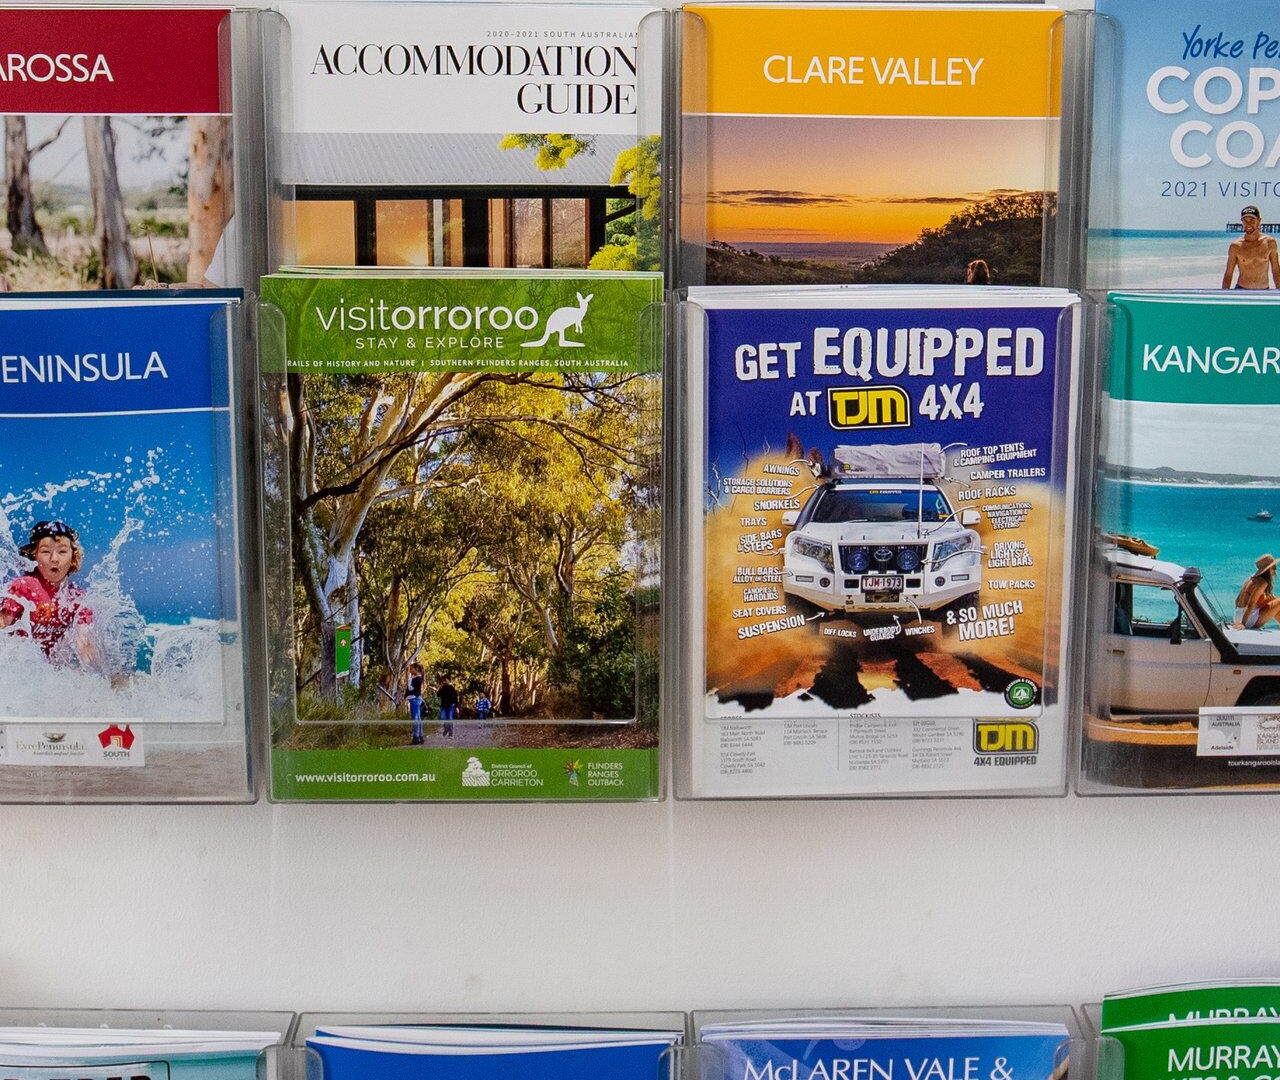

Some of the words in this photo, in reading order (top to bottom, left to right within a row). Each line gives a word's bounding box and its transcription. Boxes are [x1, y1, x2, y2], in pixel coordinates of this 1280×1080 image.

[310, 44, 638, 77] ACCOMMODATION
[764, 56, 865, 85] CLARE
[873, 57, 984, 86] VALLEY
[517, 83, 636, 115] GUIDE
[316, 299, 539, 332] visitorroroo
[735, 341, 801, 381] GET
[813, 328, 1044, 381] EQUIPPED
[790, 392, 822, 416] AT
[919, 382, 984, 420] 4X4
[295, 772, 436, 783] www.visitorroroo.com.au
